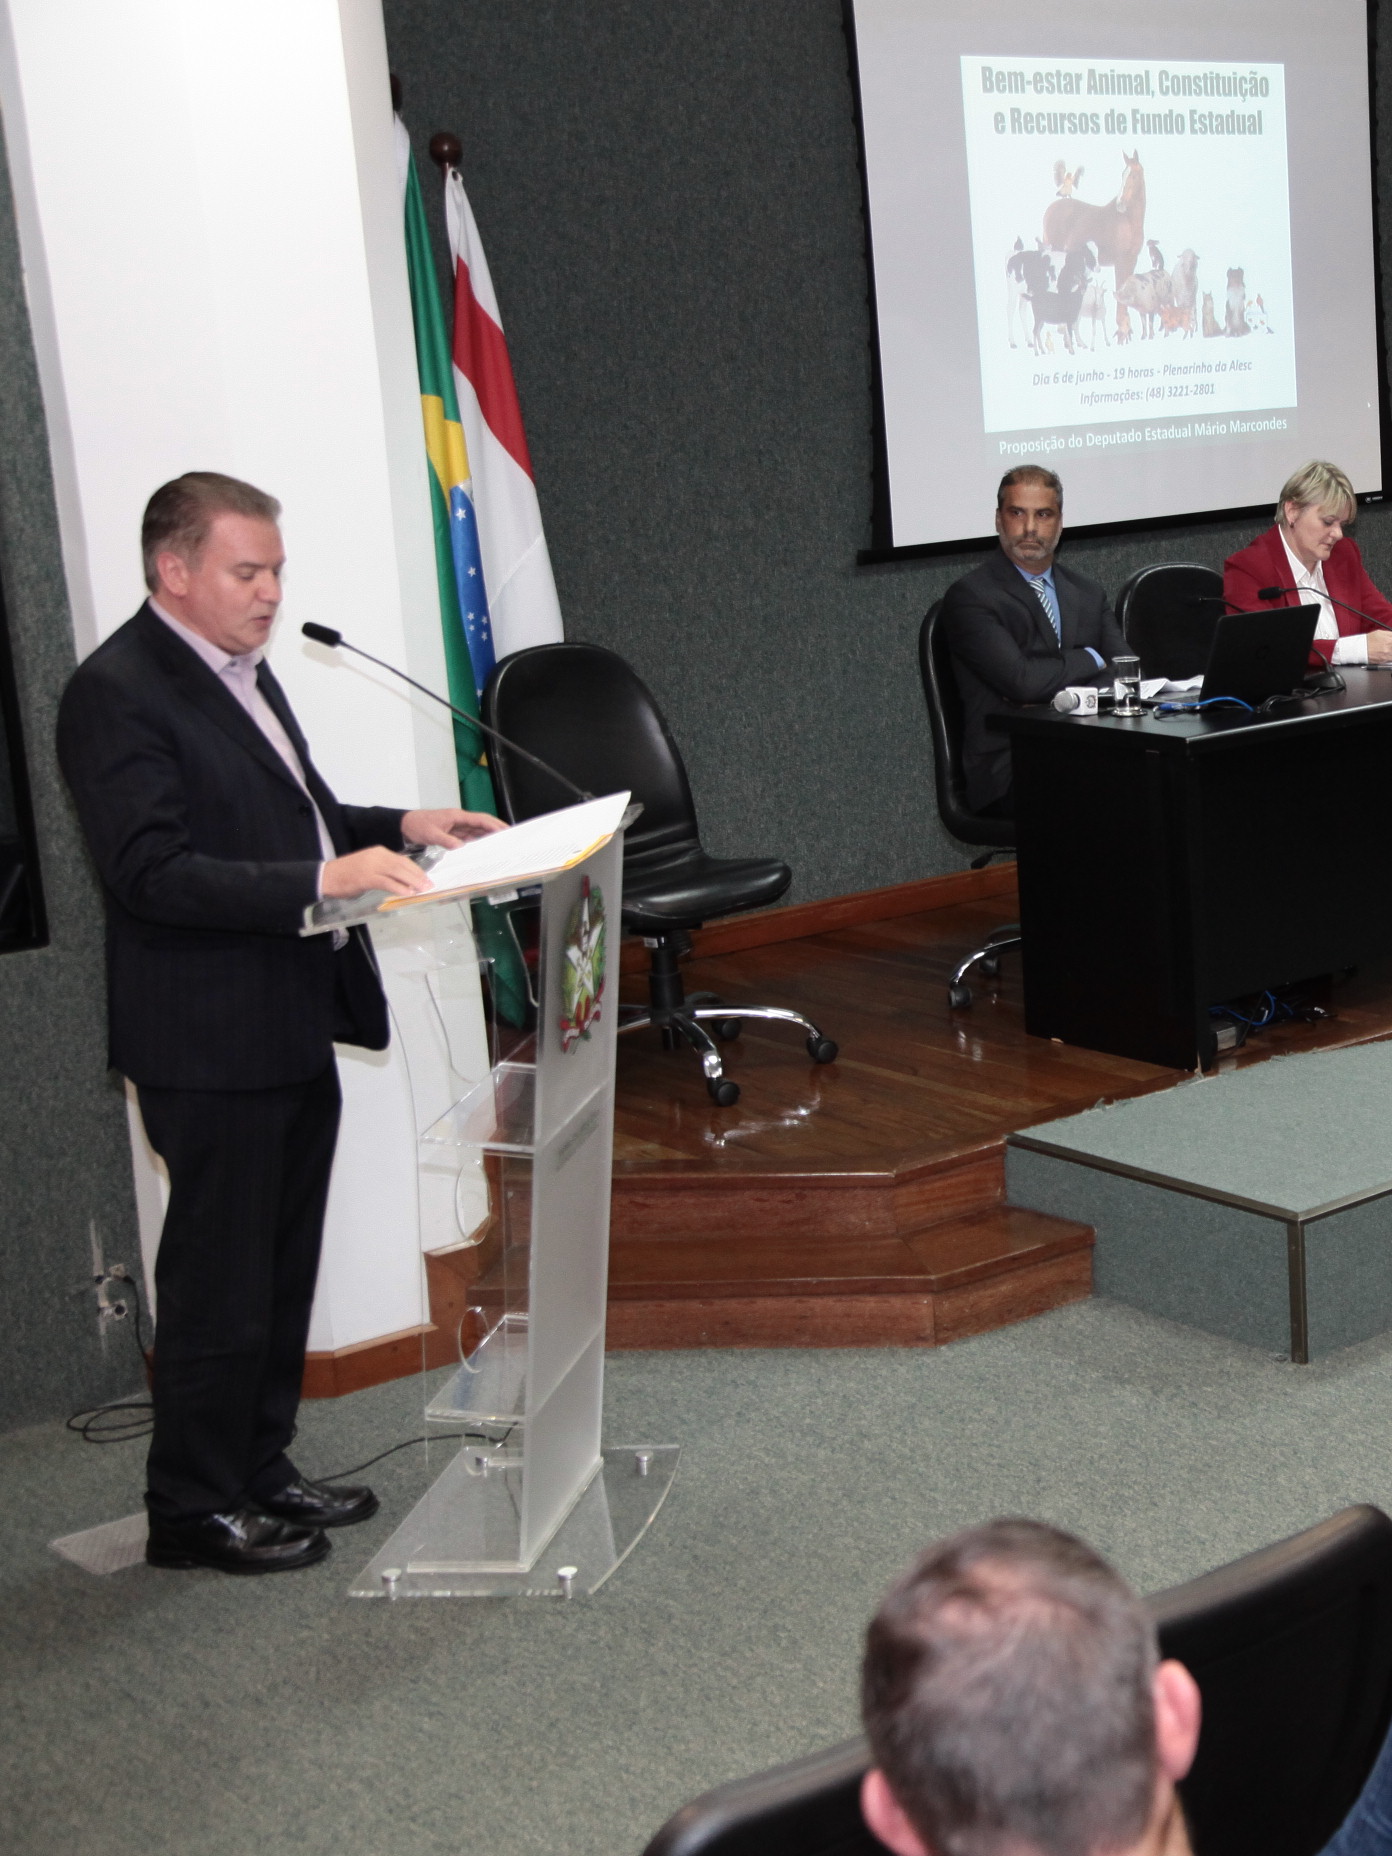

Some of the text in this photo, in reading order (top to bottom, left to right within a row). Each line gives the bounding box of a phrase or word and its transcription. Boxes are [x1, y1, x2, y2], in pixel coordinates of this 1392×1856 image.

[981, 66, 1270, 102] Bem-estar Animal, Constituição
[993, 107, 1263, 136] e Recursos de Fundo Estadual
[1032, 374, 1050, 386] Dia
[1053, 373, 1059, 384] 6
[1062, 371, 1074, 384] de
[1075, 369, 1104, 386] junho
[1113, 368, 1125, 380] 19
[1127, 366, 1154, 380] horas
[1162, 362, 1212, 377] Plenarinho
[1214, 360, 1227, 373] da
[1229, 359, 1252, 373] Alesc
[1080, 383, 1215, 406] Informações: (48) 3221-2801
[999, 416, 1288, 455] Proposição do Deputado Estadual Mário Marcondes
